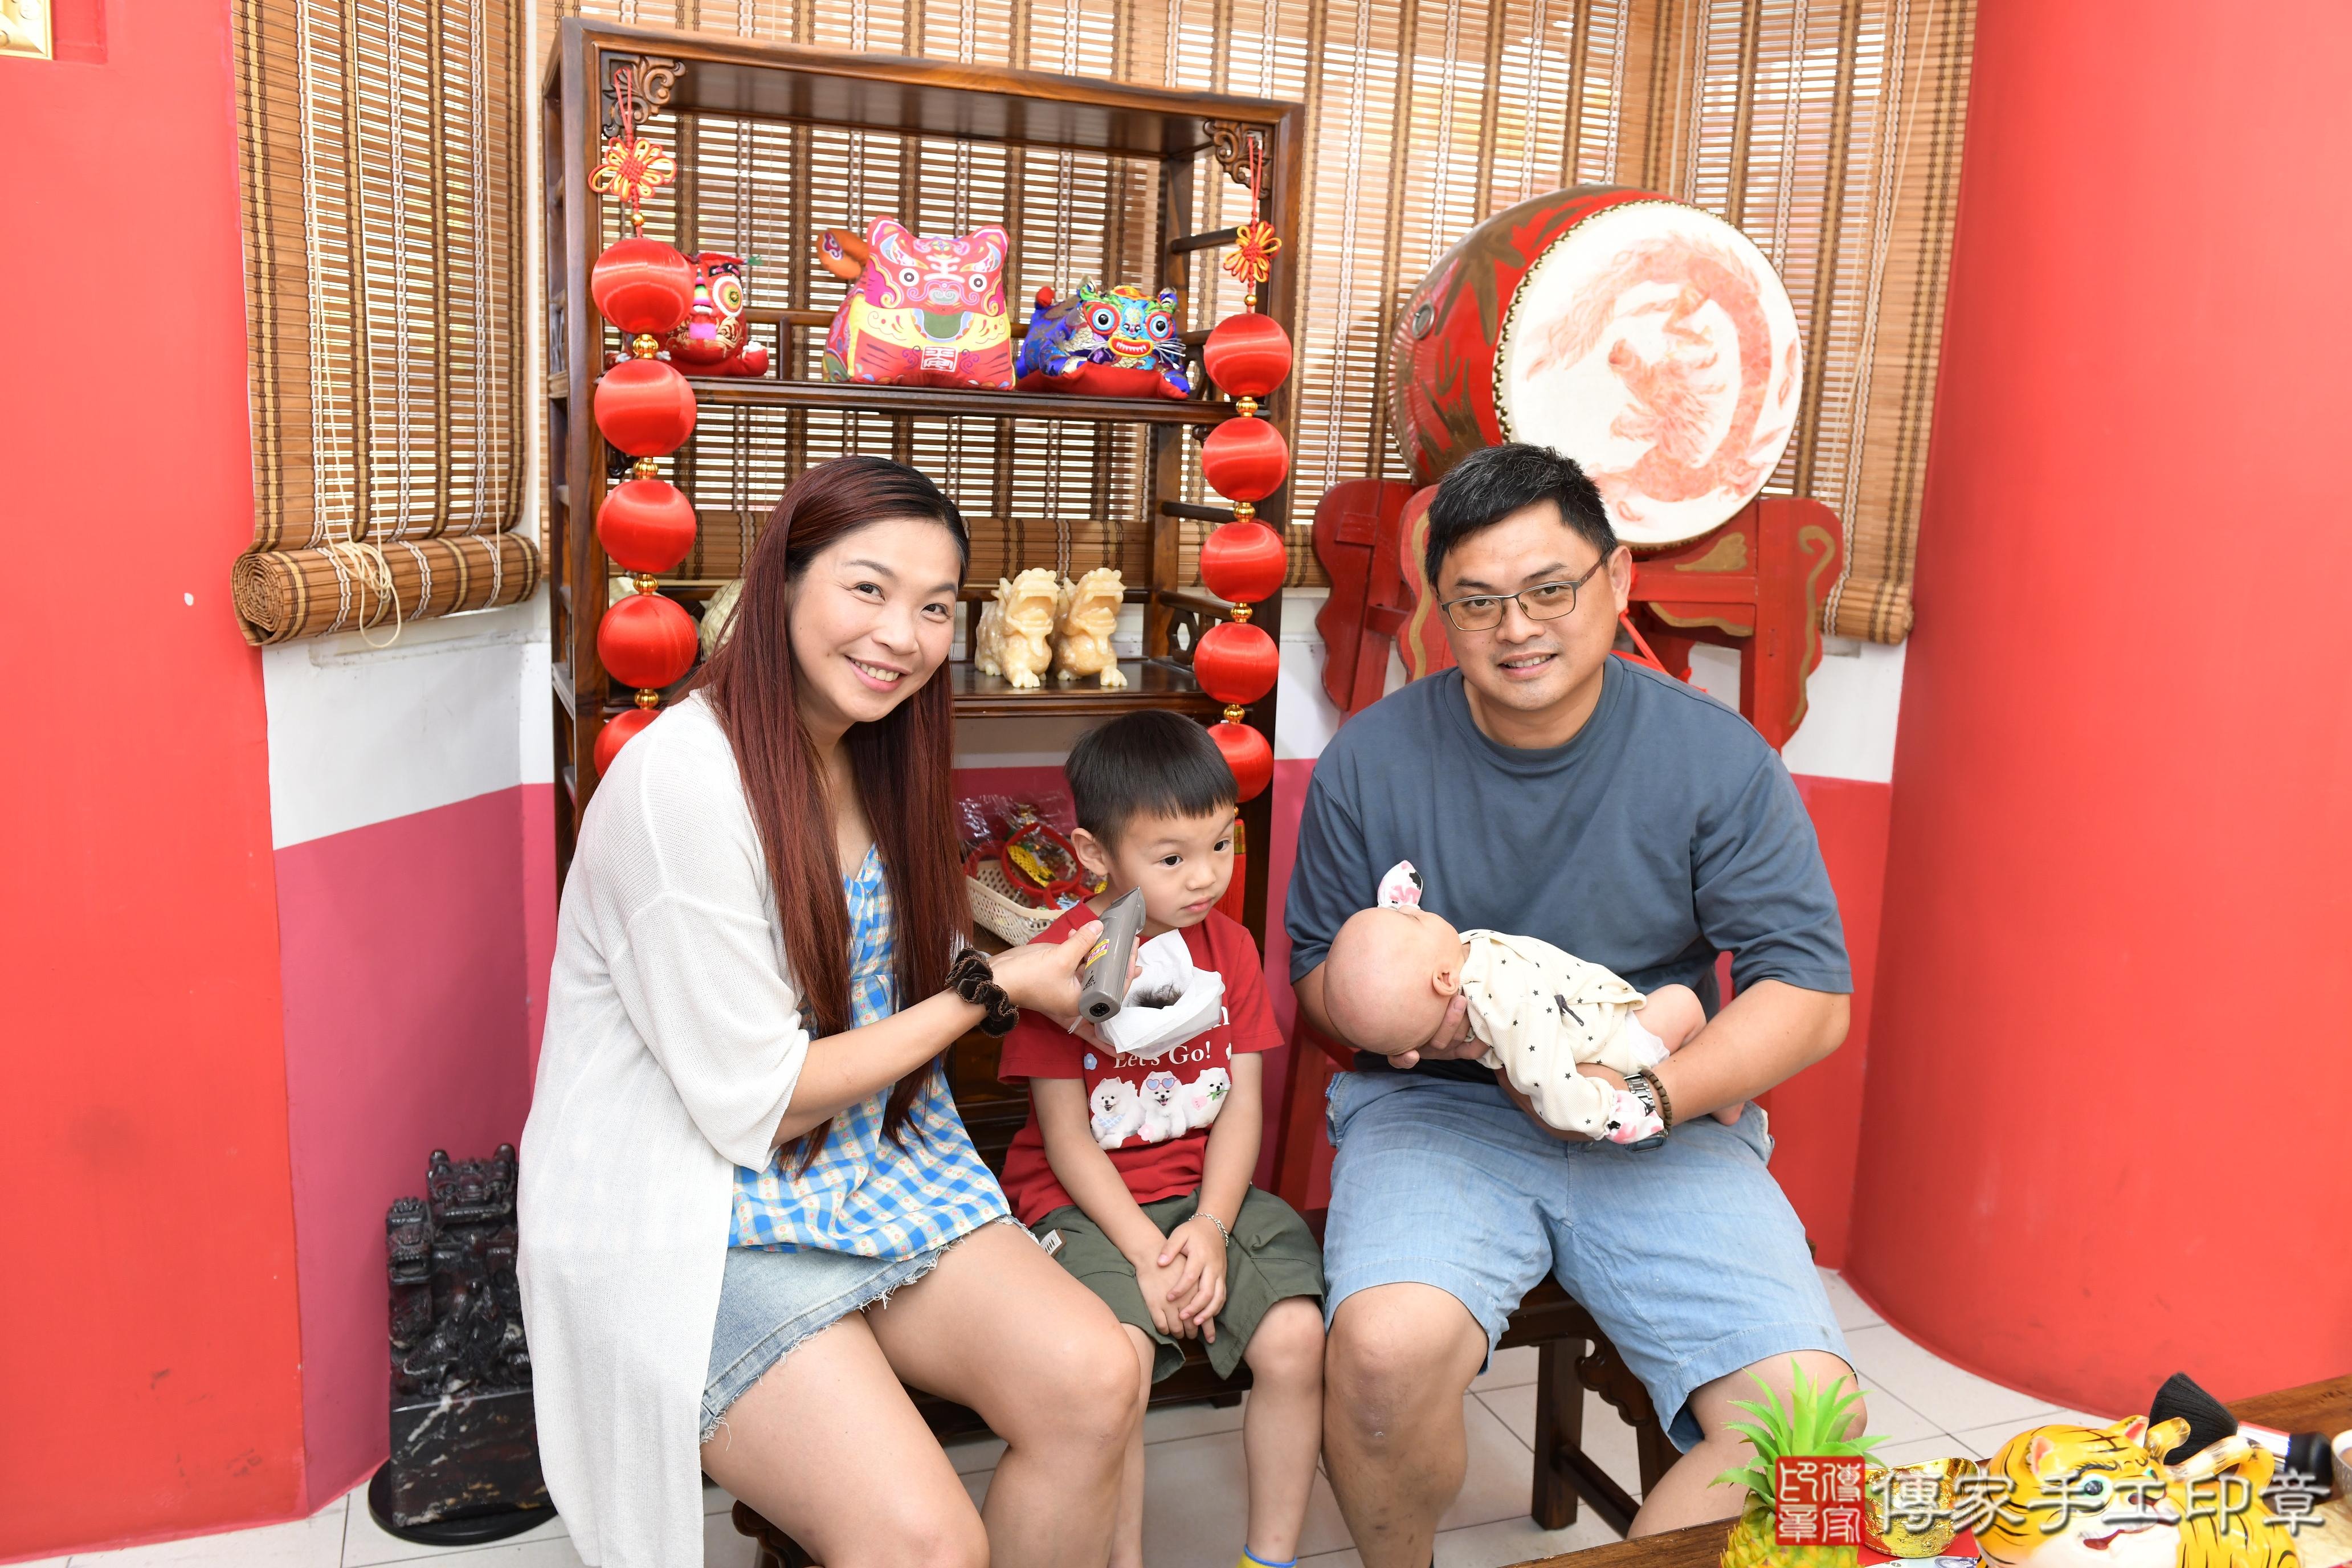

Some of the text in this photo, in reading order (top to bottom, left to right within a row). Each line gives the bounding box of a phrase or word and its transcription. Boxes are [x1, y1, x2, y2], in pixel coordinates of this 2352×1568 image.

[924, 255, 965, 283] 王
[1113, 1040, 1211, 1068] Lets Go!
